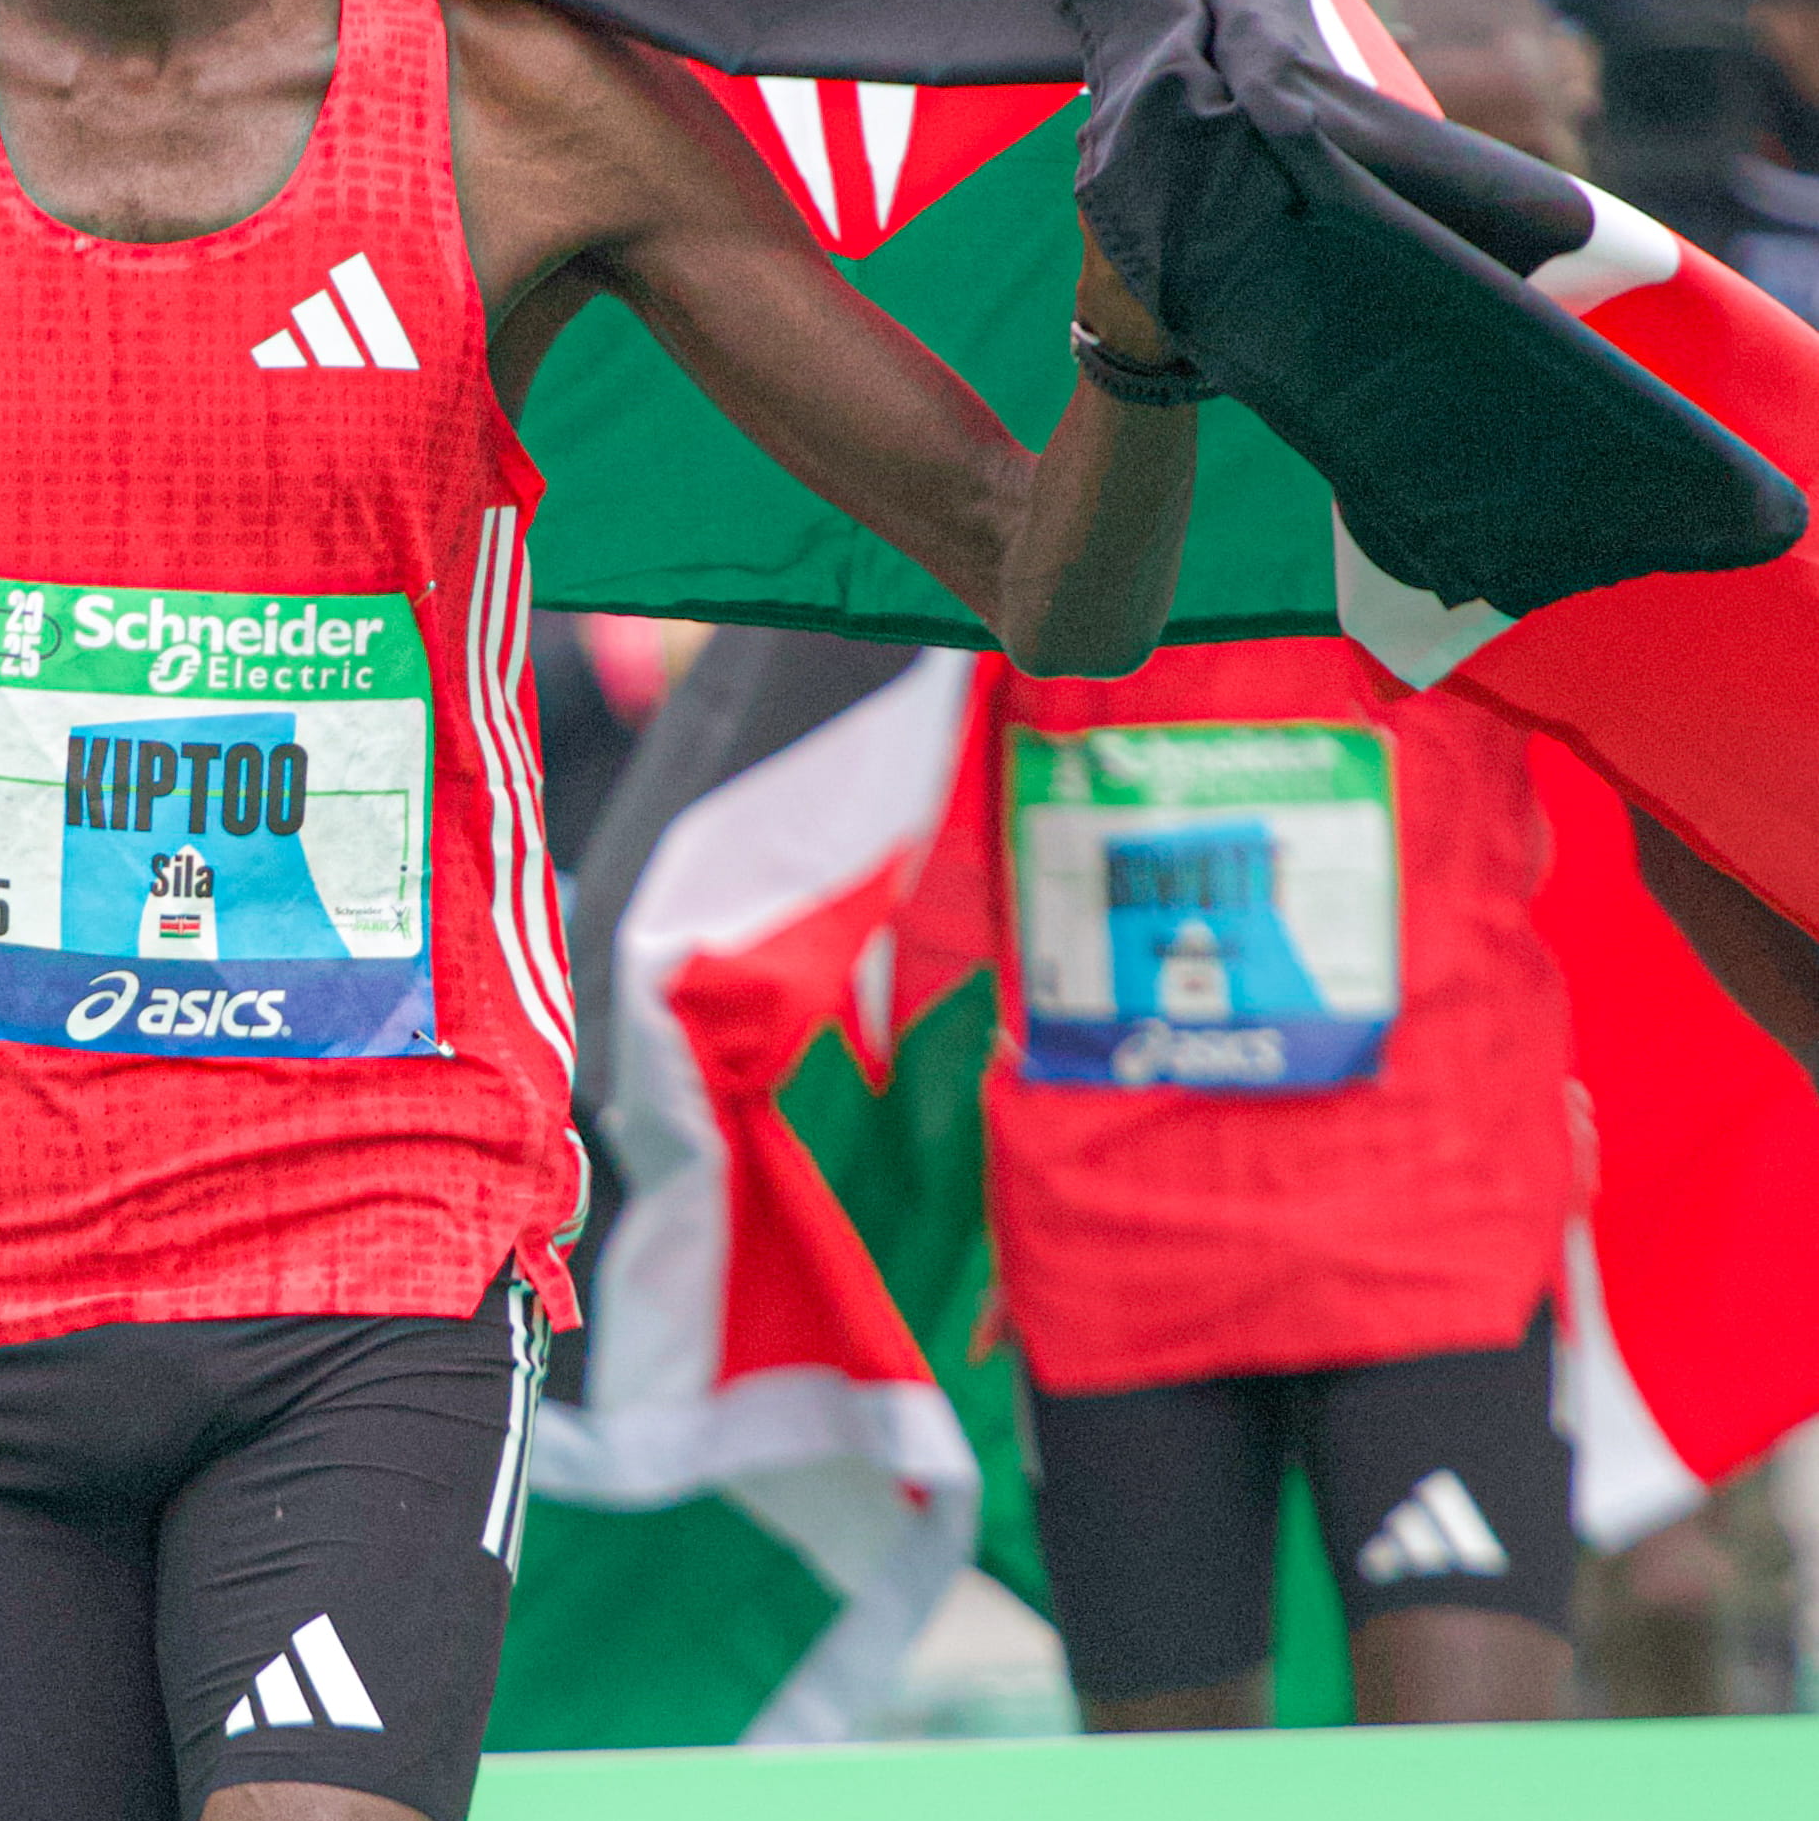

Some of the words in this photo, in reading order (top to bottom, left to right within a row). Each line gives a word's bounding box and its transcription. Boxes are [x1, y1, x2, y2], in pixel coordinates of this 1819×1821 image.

[74, 594, 383, 657] Schneider
[0, 632, 42, 678] 25
[207, 655, 374, 690] Electric
[66, 735, 309, 837] KIPTOO
[150, 853, 215, 900] Sila
